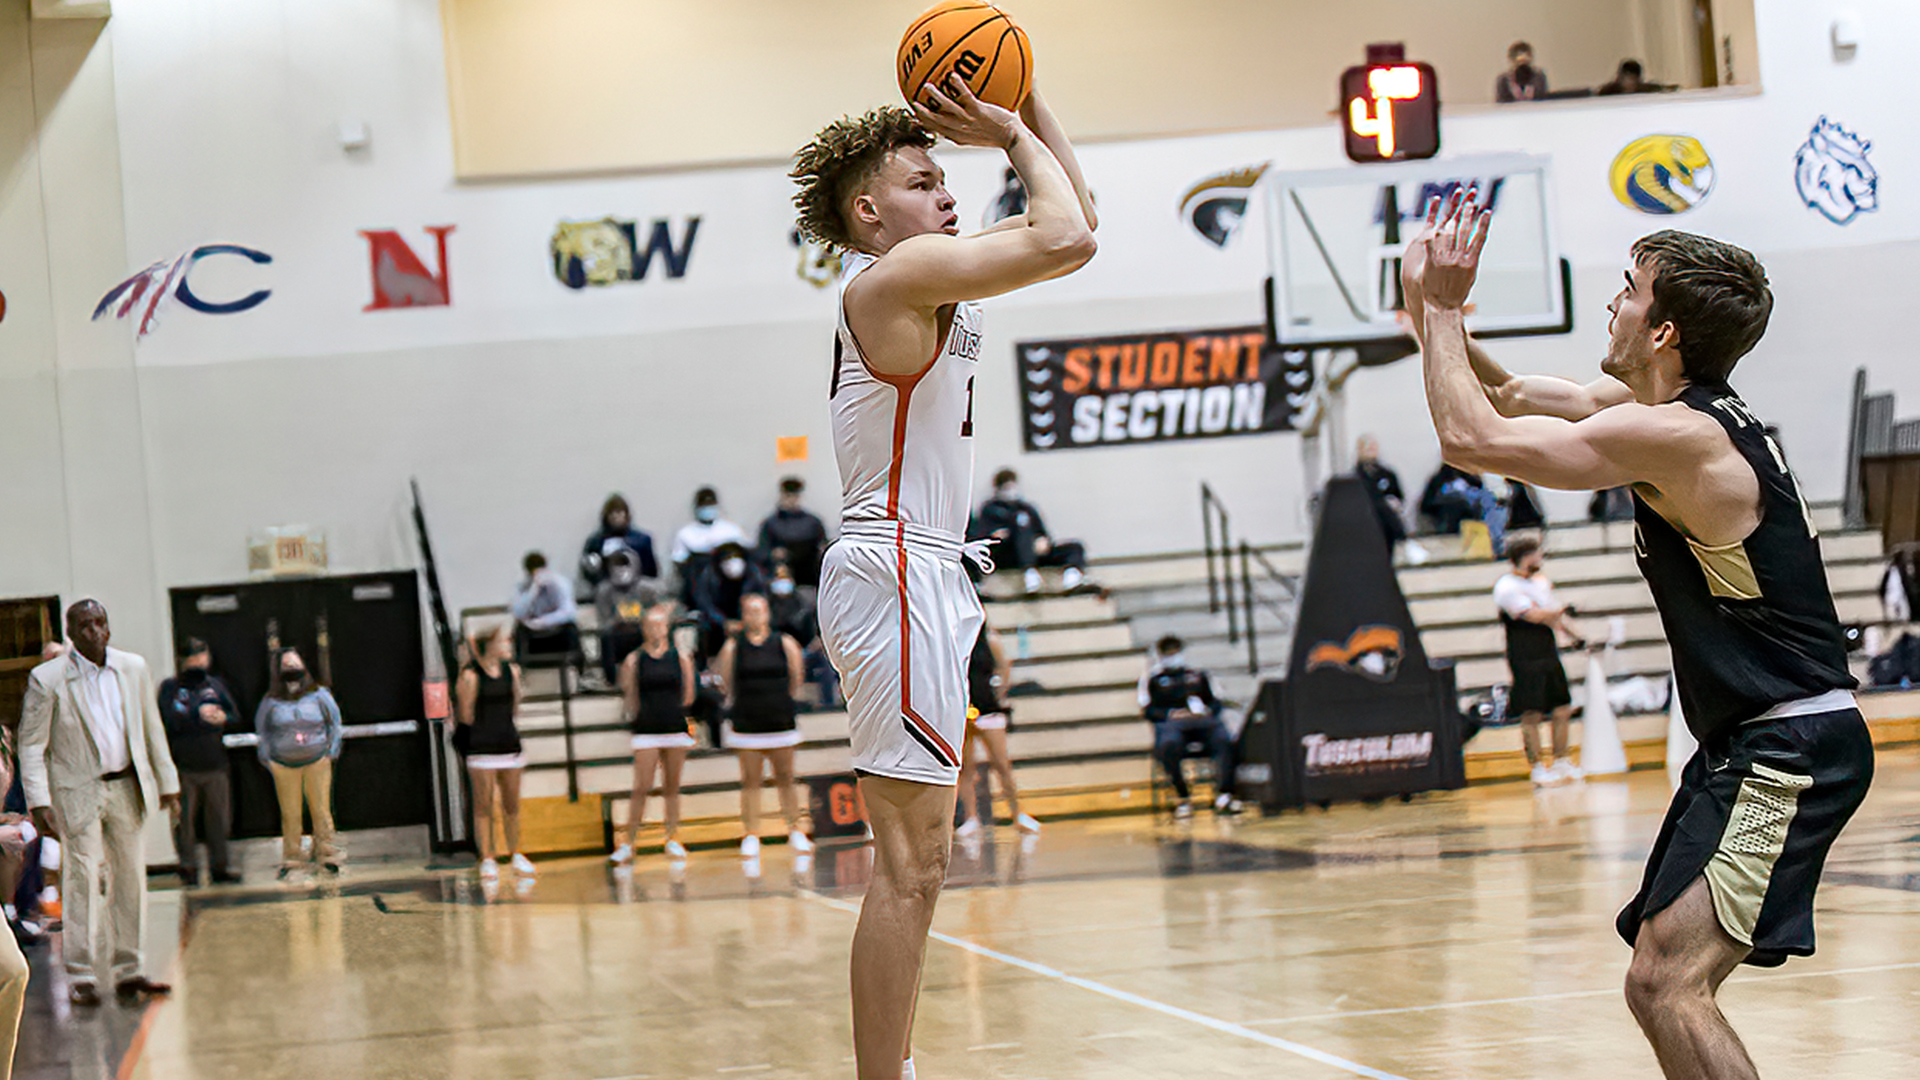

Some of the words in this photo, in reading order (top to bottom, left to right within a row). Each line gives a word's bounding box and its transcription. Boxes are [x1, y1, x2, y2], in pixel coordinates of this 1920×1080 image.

[357, 224, 457, 312] N
[1062, 333, 1267, 393] STUDENT
[1070, 381, 1266, 443] SECTION
